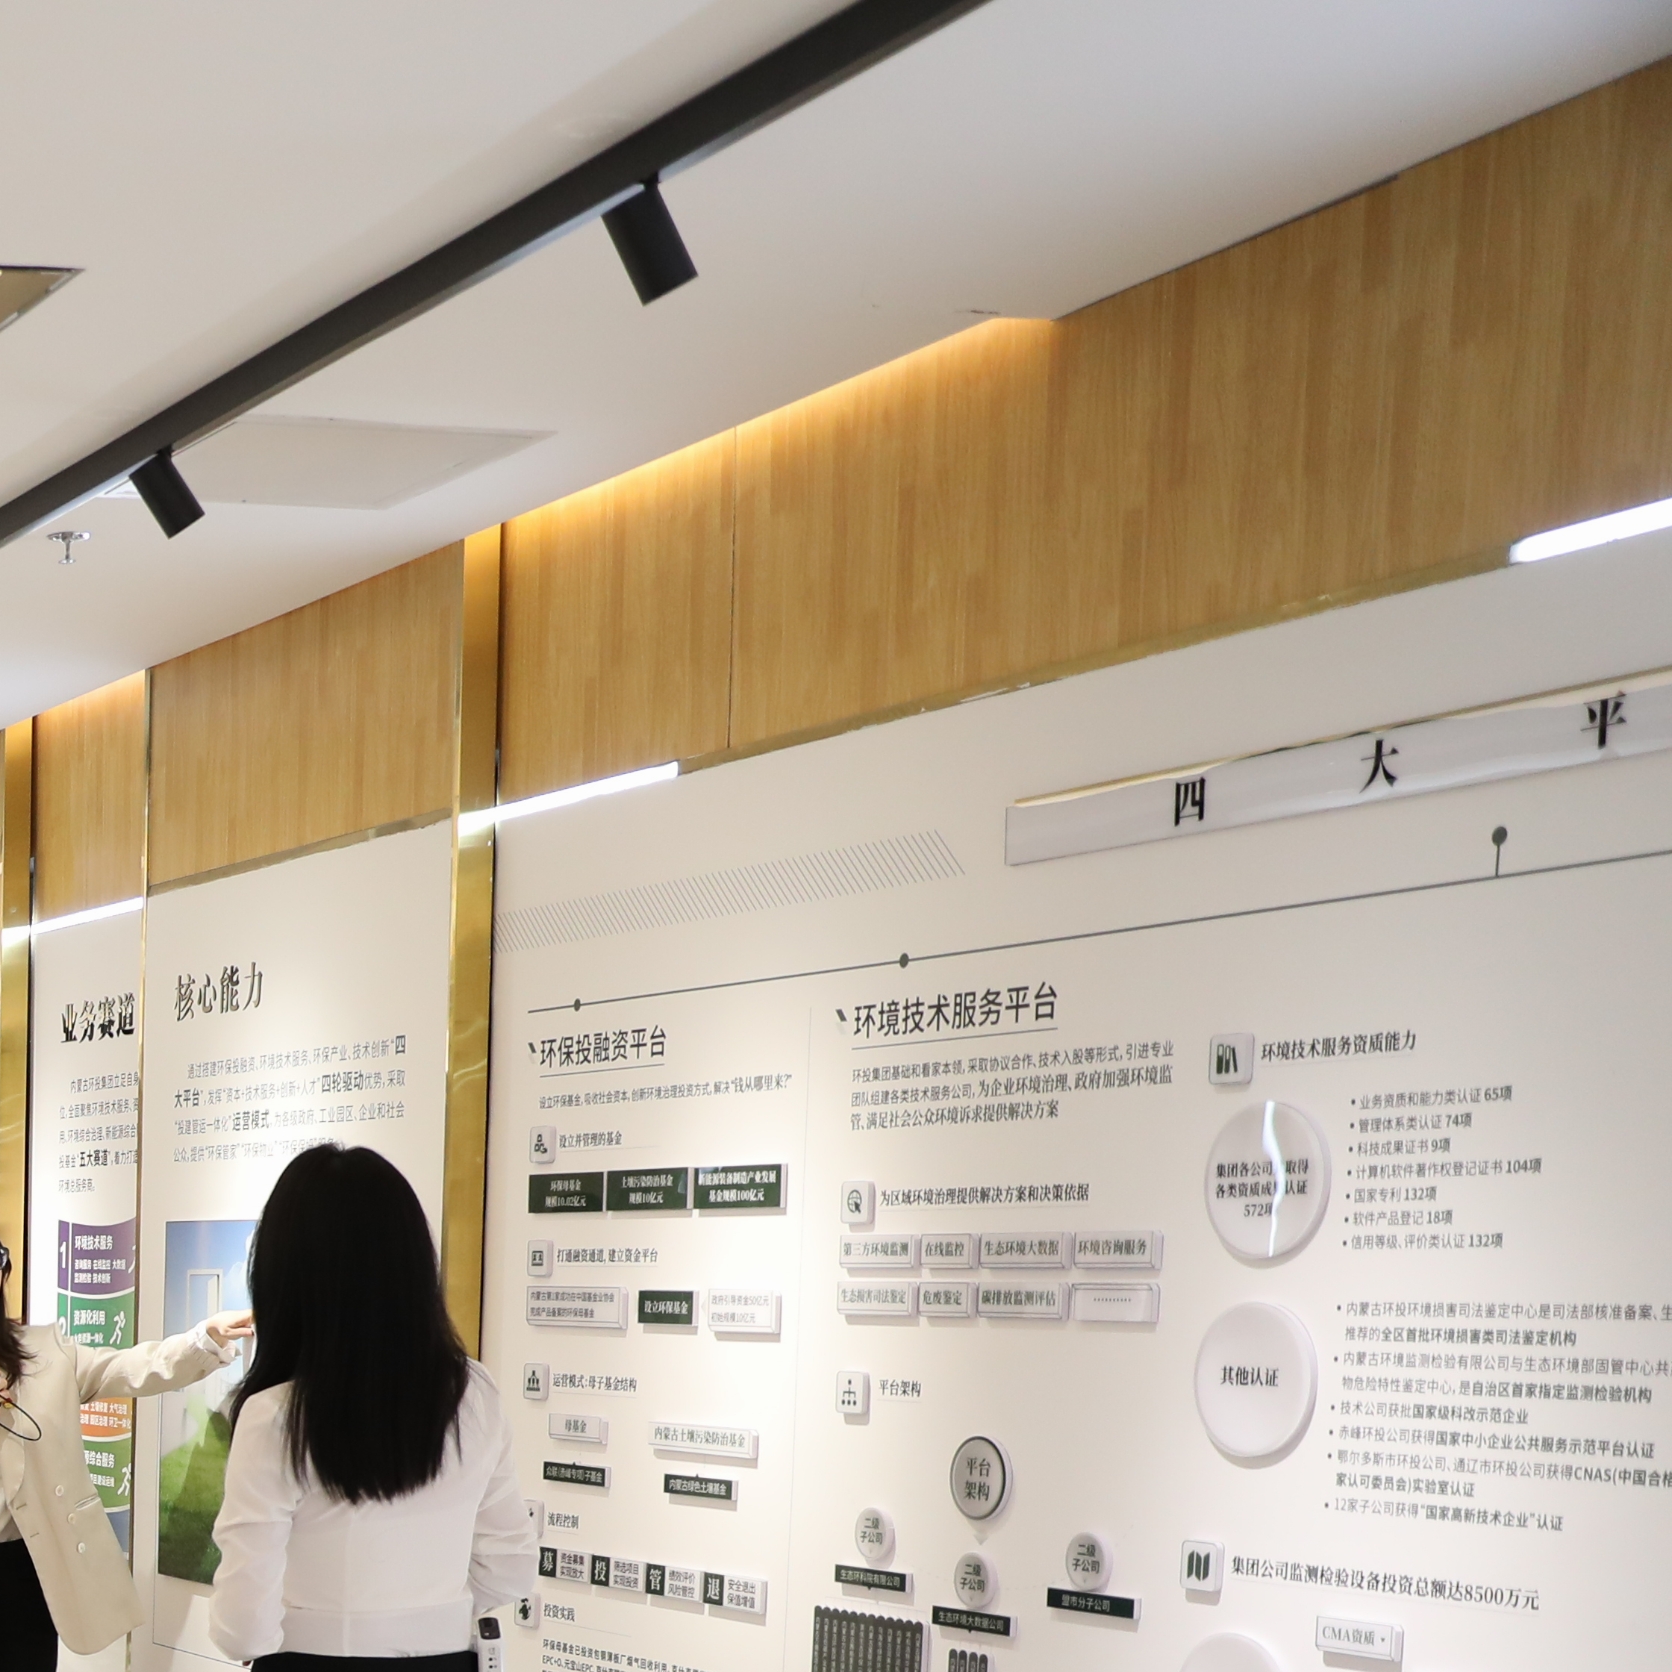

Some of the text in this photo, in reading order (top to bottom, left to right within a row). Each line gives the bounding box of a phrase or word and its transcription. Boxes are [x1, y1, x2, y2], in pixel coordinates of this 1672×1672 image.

[1174, 691, 1627, 826] 四 大 平
[173, 962, 264, 1022] 核心能力
[60, 992, 135, 1043] 业务赛道
[854, 982, 1058, 1039] 环境技术服务平台
[539, 1025, 667, 1068] 环保投融资平台
[1261, 1030, 1416, 1062] 环境技术服务资质能力
[1359, 1085, 1513, 1110] 业务资质和能力类认证 65项
[1358, 1112, 1472, 1134] 管理体系类认证 74项
[558, 1131, 622, 1148] 设立并管理的基金
[1357, 1138, 1451, 1157] 科技成果证书 9项
[1216, 1158, 1309, 1178] 集团各公司取得
[1356, 1158, 1542, 1181] 计算机软件著作权登记证书 104项
[550, 1180, 581, 1191] 环保母基金
[621, 1174, 673, 1189] 土壤污染防治基金
[629, 1191, 664, 1204] 规模10亿元
[880, 1183, 1089, 1207] 为区域环境治理提供解决方案和决策依据
[1354, 1186, 1437, 1204] 国家专利 132项
[1353, 1209, 1453, 1226] 软件产品登记 18项
[74, 1235, 114, 1251] 环境技术服务
[843, 1242, 909, 1257] 第三方环境监测
[924, 1242, 964, 1257] 在线监控
[984, 1239, 1059, 1257] 生态环境大数据
[1077, 1238, 1147, 1256] 环境咨询服务
[1351, 1233, 1503, 1250] 信用等级、评价类认证 132项
[60, 1241, 67, 1269] 1
[841, 1288, 906, 1304] 生态损害司法鉴定
[922, 1289, 963, 1306] 危废鉴定
[981, 1288, 1056, 1308] 碳排放监测评估
[73, 1309, 106, 1326] 资源化利用
[644, 1300, 689, 1316] 设立环保基金
[1345, 1326, 1577, 1347] 推荐的全区首批环境损害类司法鉴定机构
[1343, 1351, 1672, 1377] 内蒙古环境监测检验有限公司与生态环境部固管中心共
[1220, 1365, 1279, 1387] 其他认证
[879, 1379, 922, 1398] 平台架构
[1340, 1401, 1529, 1424] 技术公司获批国家级科改示范企业
[564, 1419, 587, 1434] 母基金
[654, 1426, 746, 1448] 内蒙古土壤污染防治基金
[966, 1456, 992, 1478] 平台
[964, 1479, 990, 1502] 架构
[547, 1511, 579, 1530] 流程控制
[864, 1517, 880, 1530] 二级
[860, 1531, 883, 1545] 子公司
[1077, 1543, 1096, 1557] 二级
[542, 1551, 554, 1572] 募
[594, 1560, 606, 1582] 投
[964, 1563, 982, 1577] 二级
[1072, 1558, 1100, 1574] 子公司
[649, 1568, 662, 1591] 管
[706, 1577, 720, 1600] 退
[960, 1577, 985, 1593] 子公司
[1232, 1556, 1540, 1611] 集团公司监测检验设备投资总额达8500万元
[543, 1602, 576, 1622] 投资实践
[1061, 1593, 1111, 1612] 盟市分子公司
[1322, 1626, 1375, 1646] CMA资质
